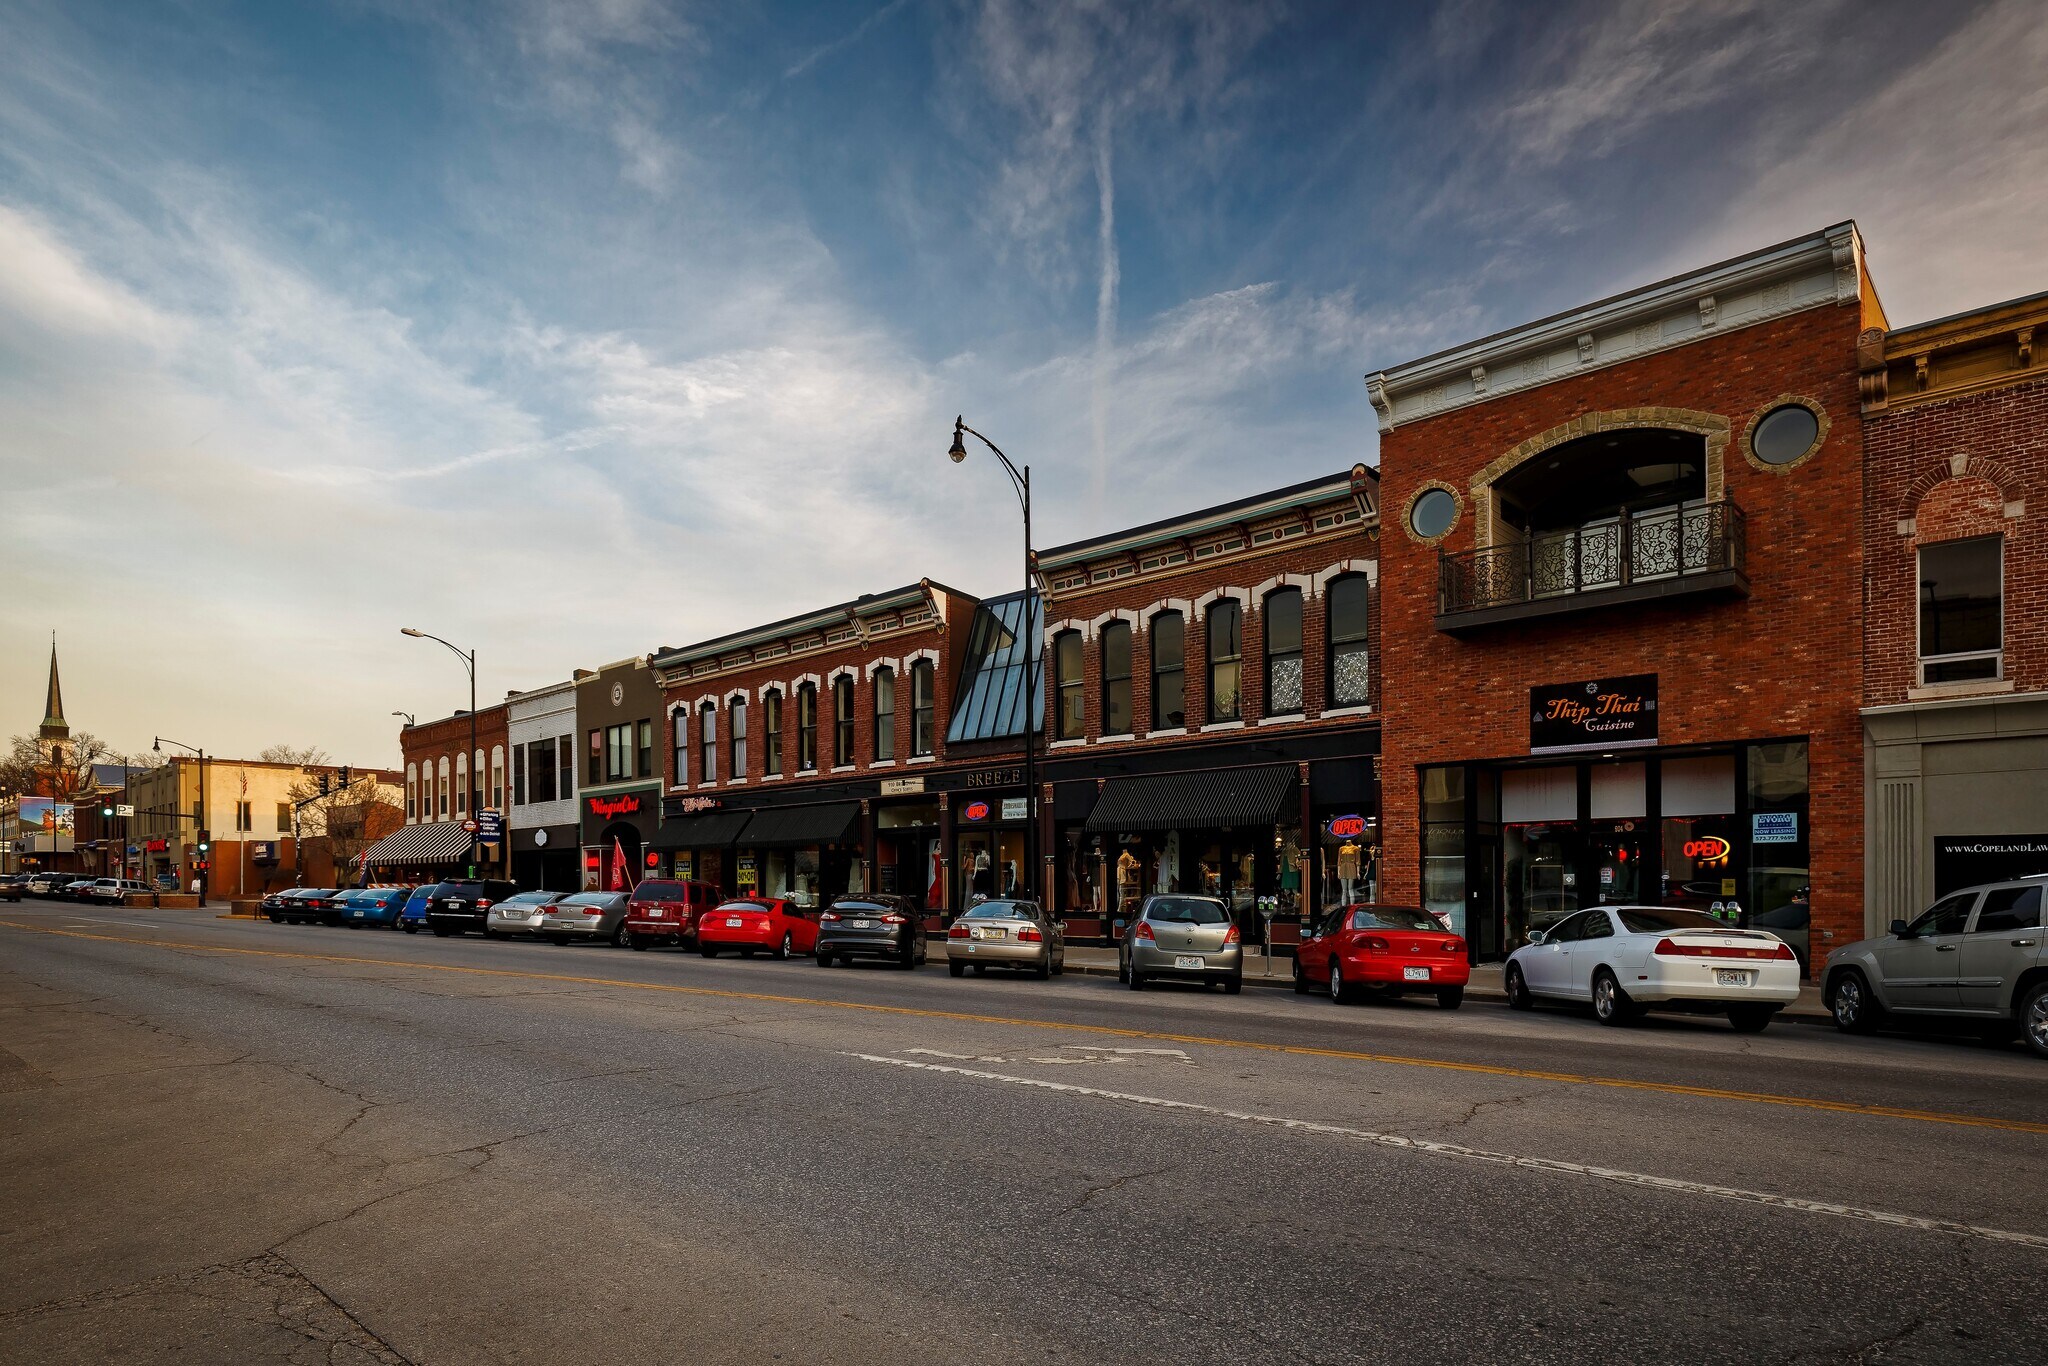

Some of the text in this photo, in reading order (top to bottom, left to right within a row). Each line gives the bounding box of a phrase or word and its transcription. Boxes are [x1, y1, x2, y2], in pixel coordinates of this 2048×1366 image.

[1546, 693, 1641, 724] Thip Thai
[1582, 717, 1635, 732] Cuisine
[967, 769, 1020, 787] BREEZE
[967, 805, 987, 819] OPEN
[1758, 814, 1792, 824] EVORG
[1332, 819, 1364, 835] OPEN
[1169, 838, 1177, 871] SALE
[1683, 840, 1723, 857] OPEN
